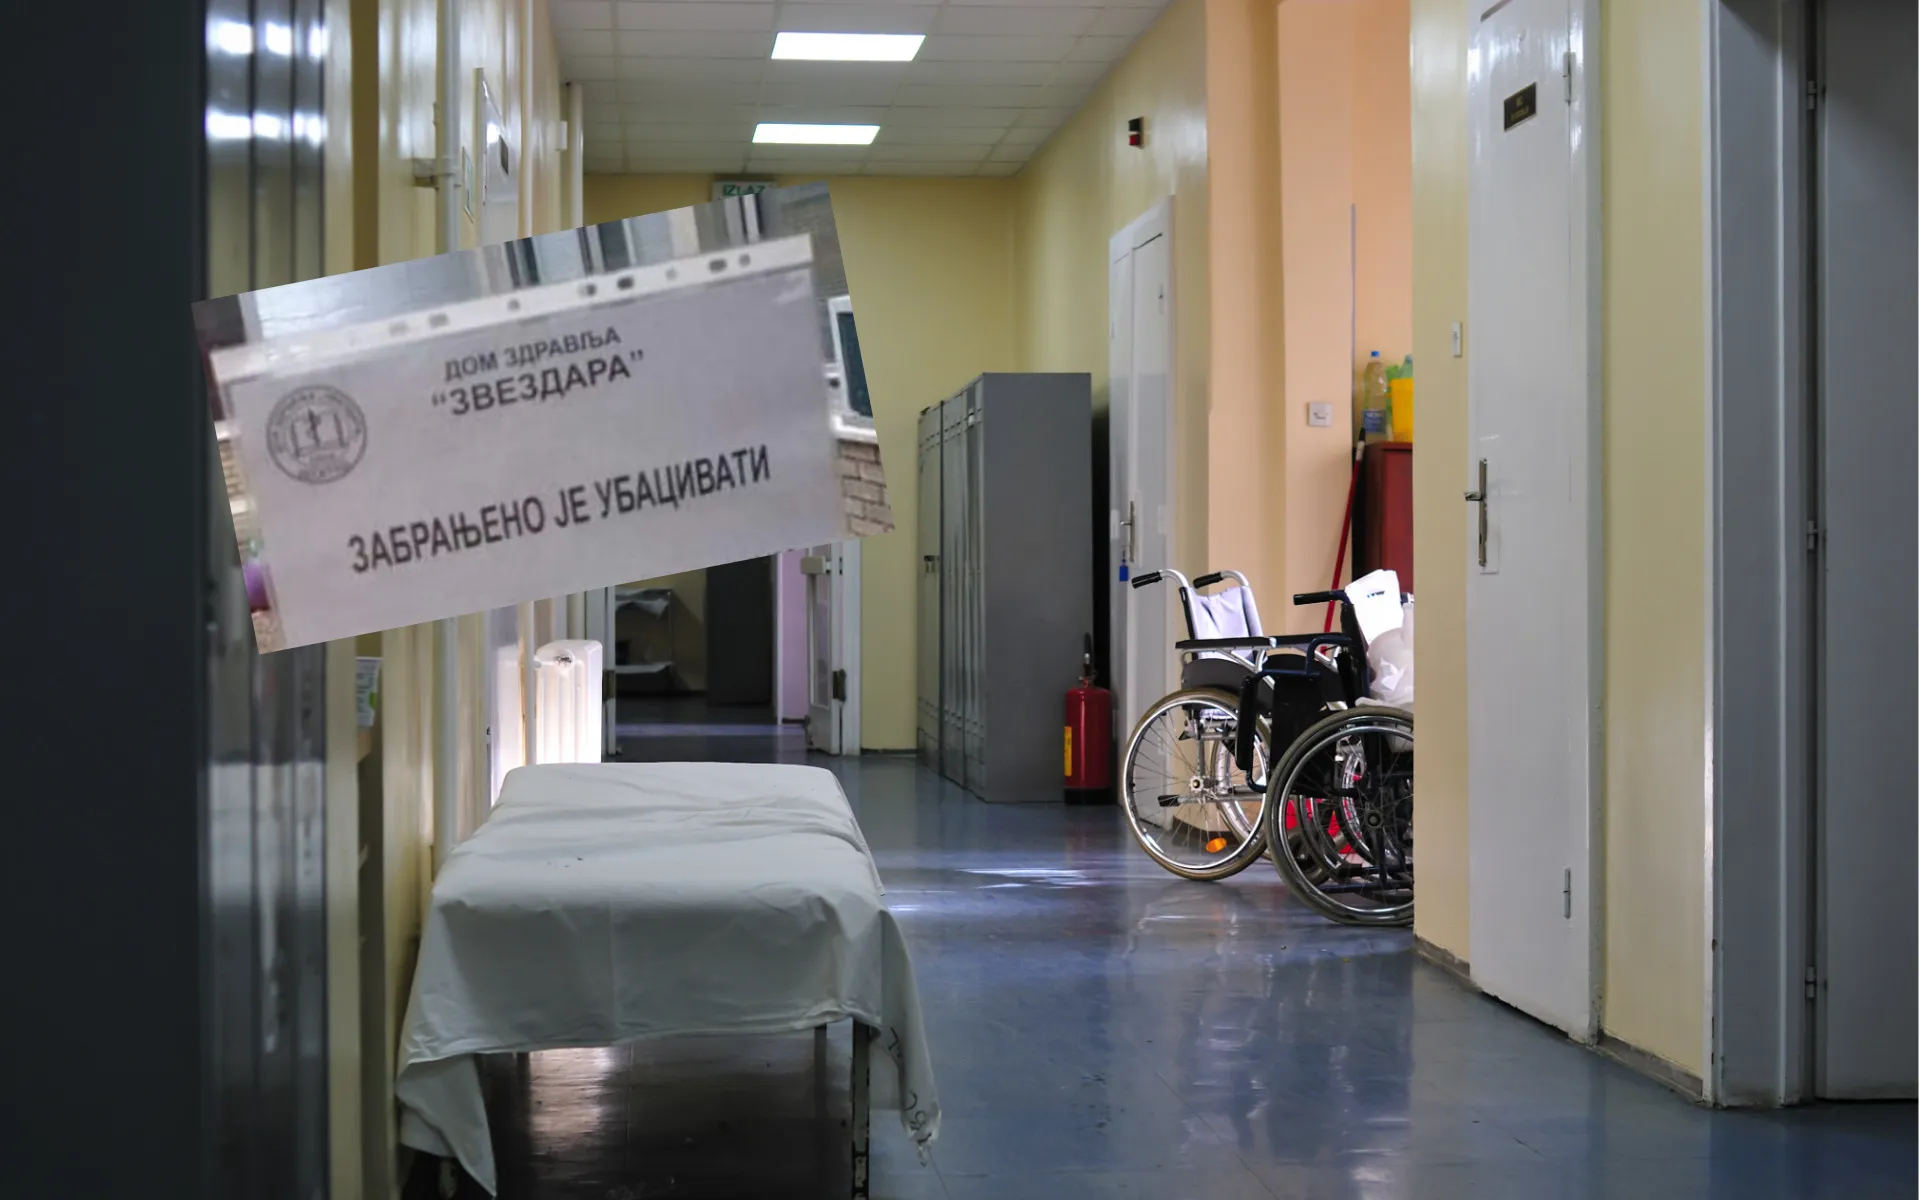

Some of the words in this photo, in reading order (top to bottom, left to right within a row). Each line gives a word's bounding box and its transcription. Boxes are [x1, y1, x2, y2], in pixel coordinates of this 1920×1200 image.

[445, 352, 498, 382] ДОМ
[504, 327, 621, 367] ЗДРАВЉА
[348, 496, 546, 573] ЗАБРАЊЕНО
[554, 486, 591, 528] ЈЕ
[594, 444, 770, 518] УБАЦИВАТИ
